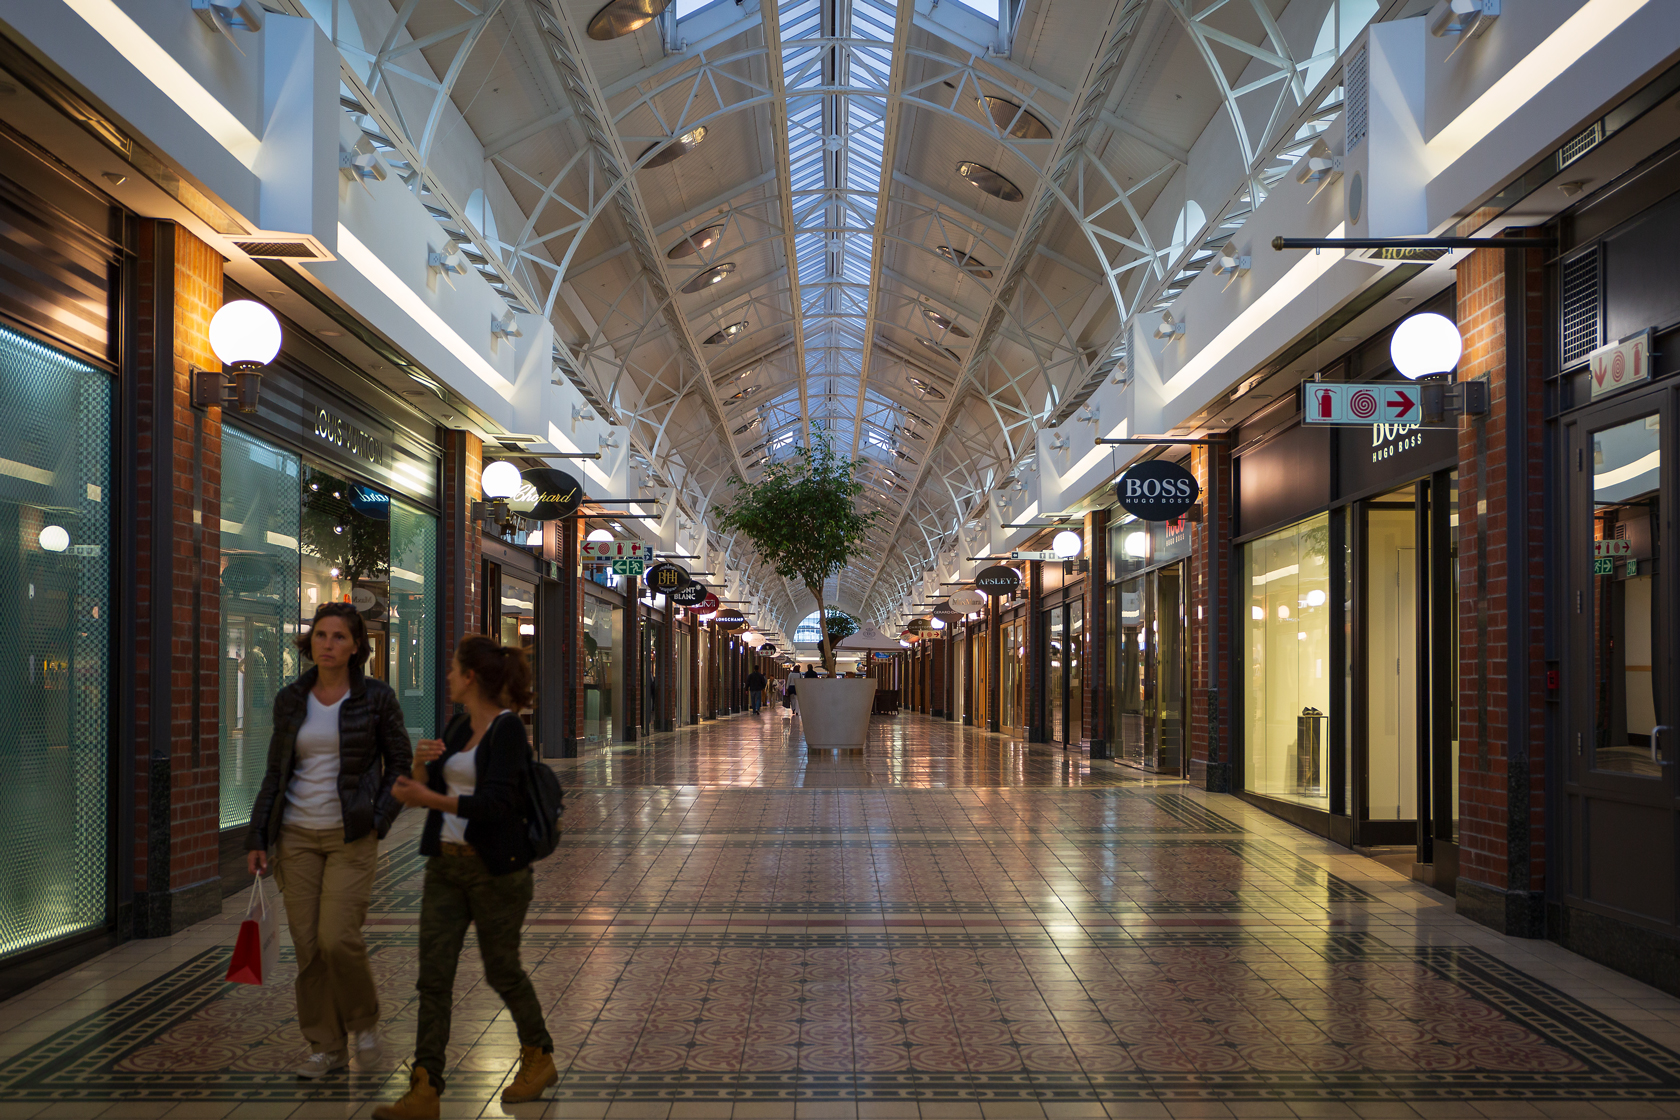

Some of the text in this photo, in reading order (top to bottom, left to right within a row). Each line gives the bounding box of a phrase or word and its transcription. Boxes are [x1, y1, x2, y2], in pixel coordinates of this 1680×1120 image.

[314, 405, 383, 467] LOUIS VUITTON
[1372, 445, 1394, 463] HUGO
[1398, 432, 1422, 453] BOSS
[513, 484, 577, 507] Chopard
[1125, 478, 1191, 498] BOSS
[979, 577, 1019, 586] APSLEY 2
[952, 598, 982, 606] MaxMara
